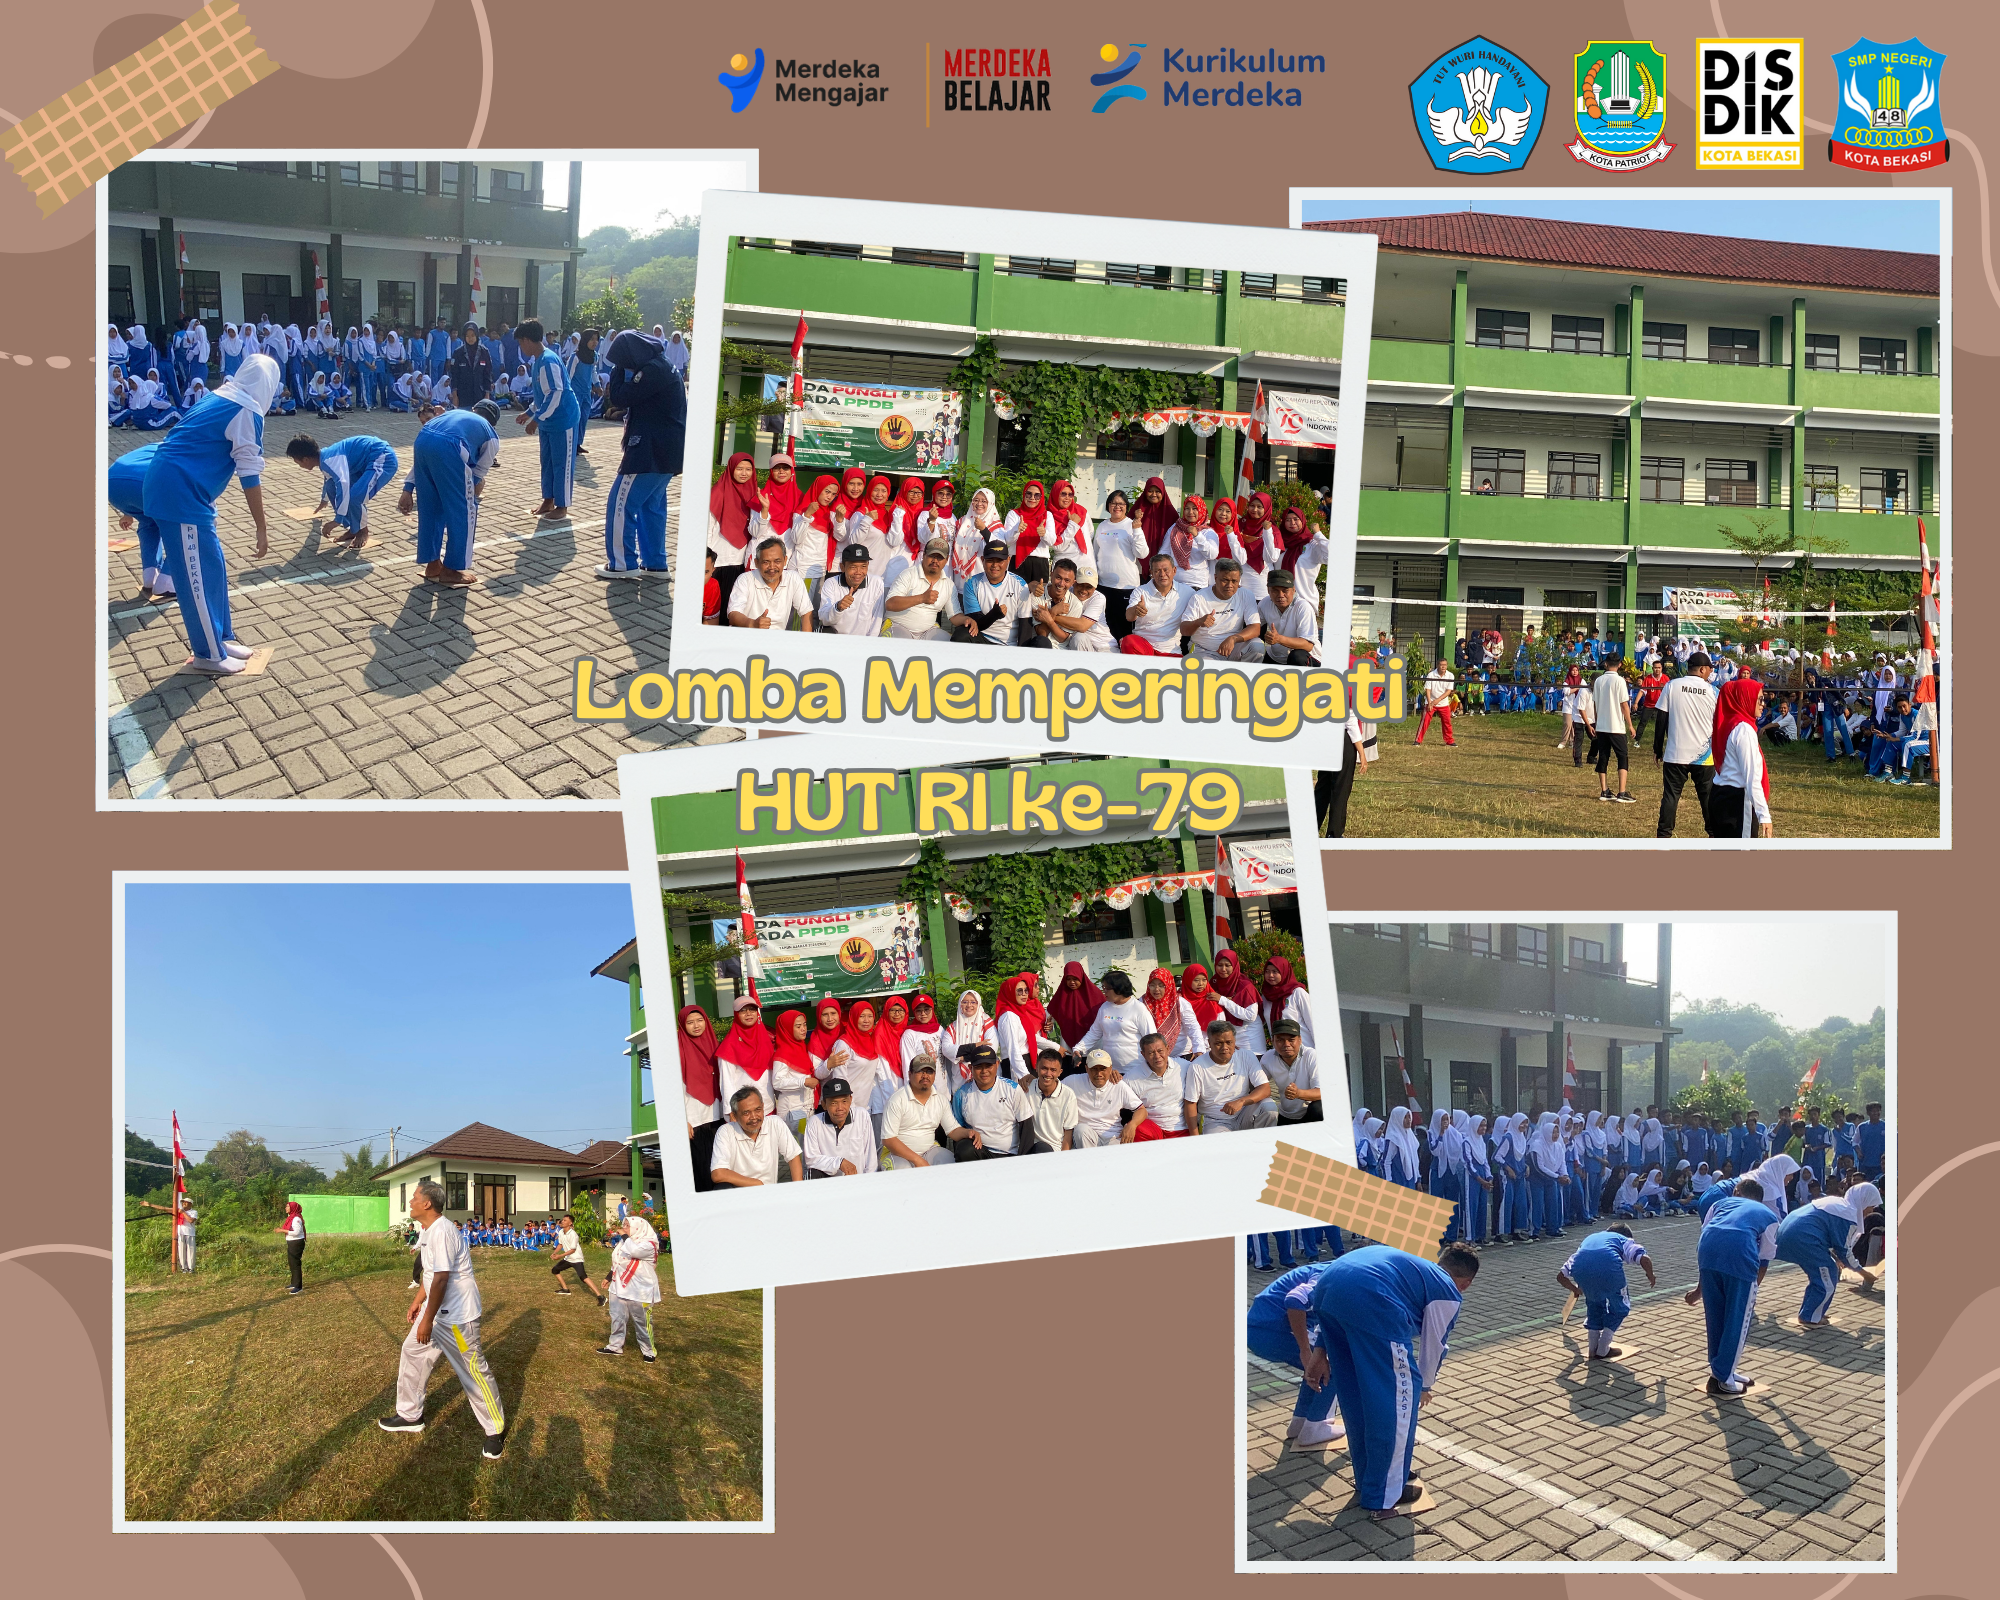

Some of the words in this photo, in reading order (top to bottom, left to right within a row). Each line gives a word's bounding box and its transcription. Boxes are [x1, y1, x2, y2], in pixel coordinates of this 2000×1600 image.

[792, 382, 829, 393] DA
[833, 386, 897, 398] PUNGLI
[803, 394, 840, 405] ADA
[844, 398, 894, 409] PPDB
[189, 556, 200, 600] BEKASI
[1681, 590, 1705, 598] ADA
[1680, 598, 1712, 606] PADA
[1681, 685, 1707, 696] MADDE
[754, 920, 781, 929] DA
[784, 914, 851, 927] PUNGLI
[757, 929, 795, 941] ADA
[798, 924, 850, 938] PPDB
[1400, 1373, 1409, 1419] BEKASI
